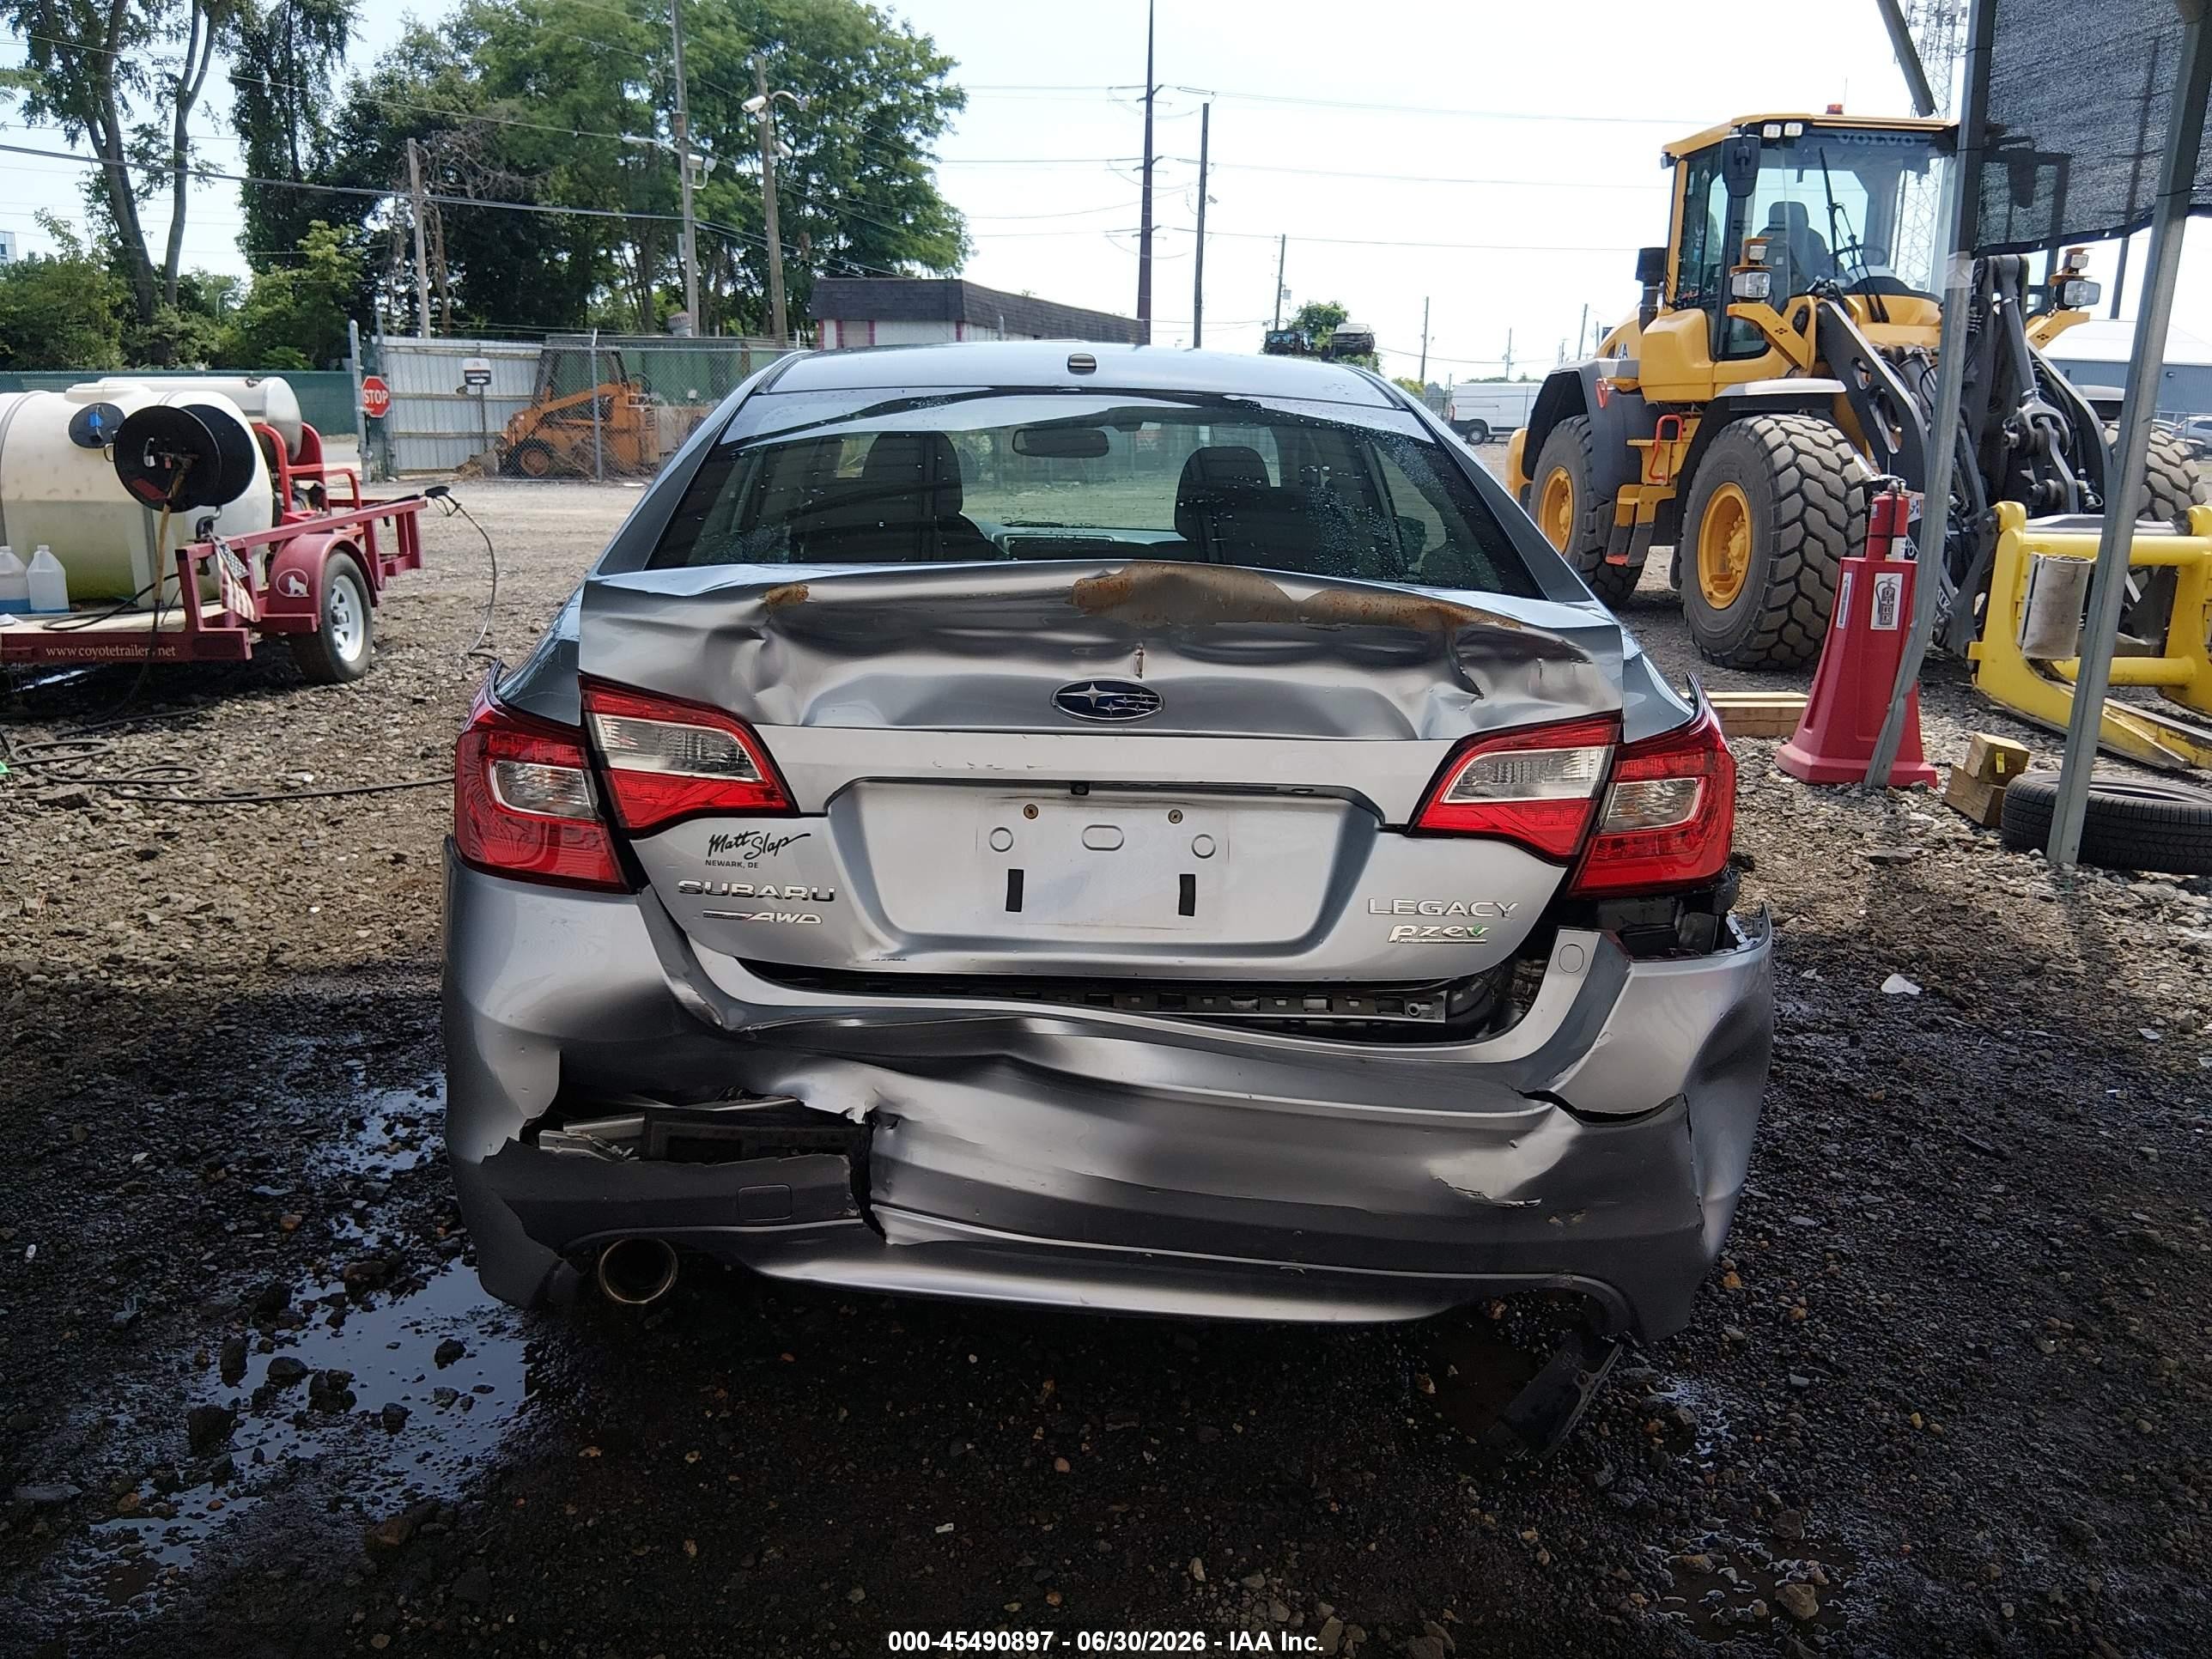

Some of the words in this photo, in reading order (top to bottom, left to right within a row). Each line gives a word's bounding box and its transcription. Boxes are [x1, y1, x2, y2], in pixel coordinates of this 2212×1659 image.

[363, 389, 389, 404] STOP
[708, 830, 761, 857] Matt
[744, 832, 811, 860] Slap
[705, 860, 745, 869] NEWARK,
[678, 880, 836, 902] SUBARU
[1368, 899, 1519, 918] LEGACY
[747, 912, 823, 924] AWD
